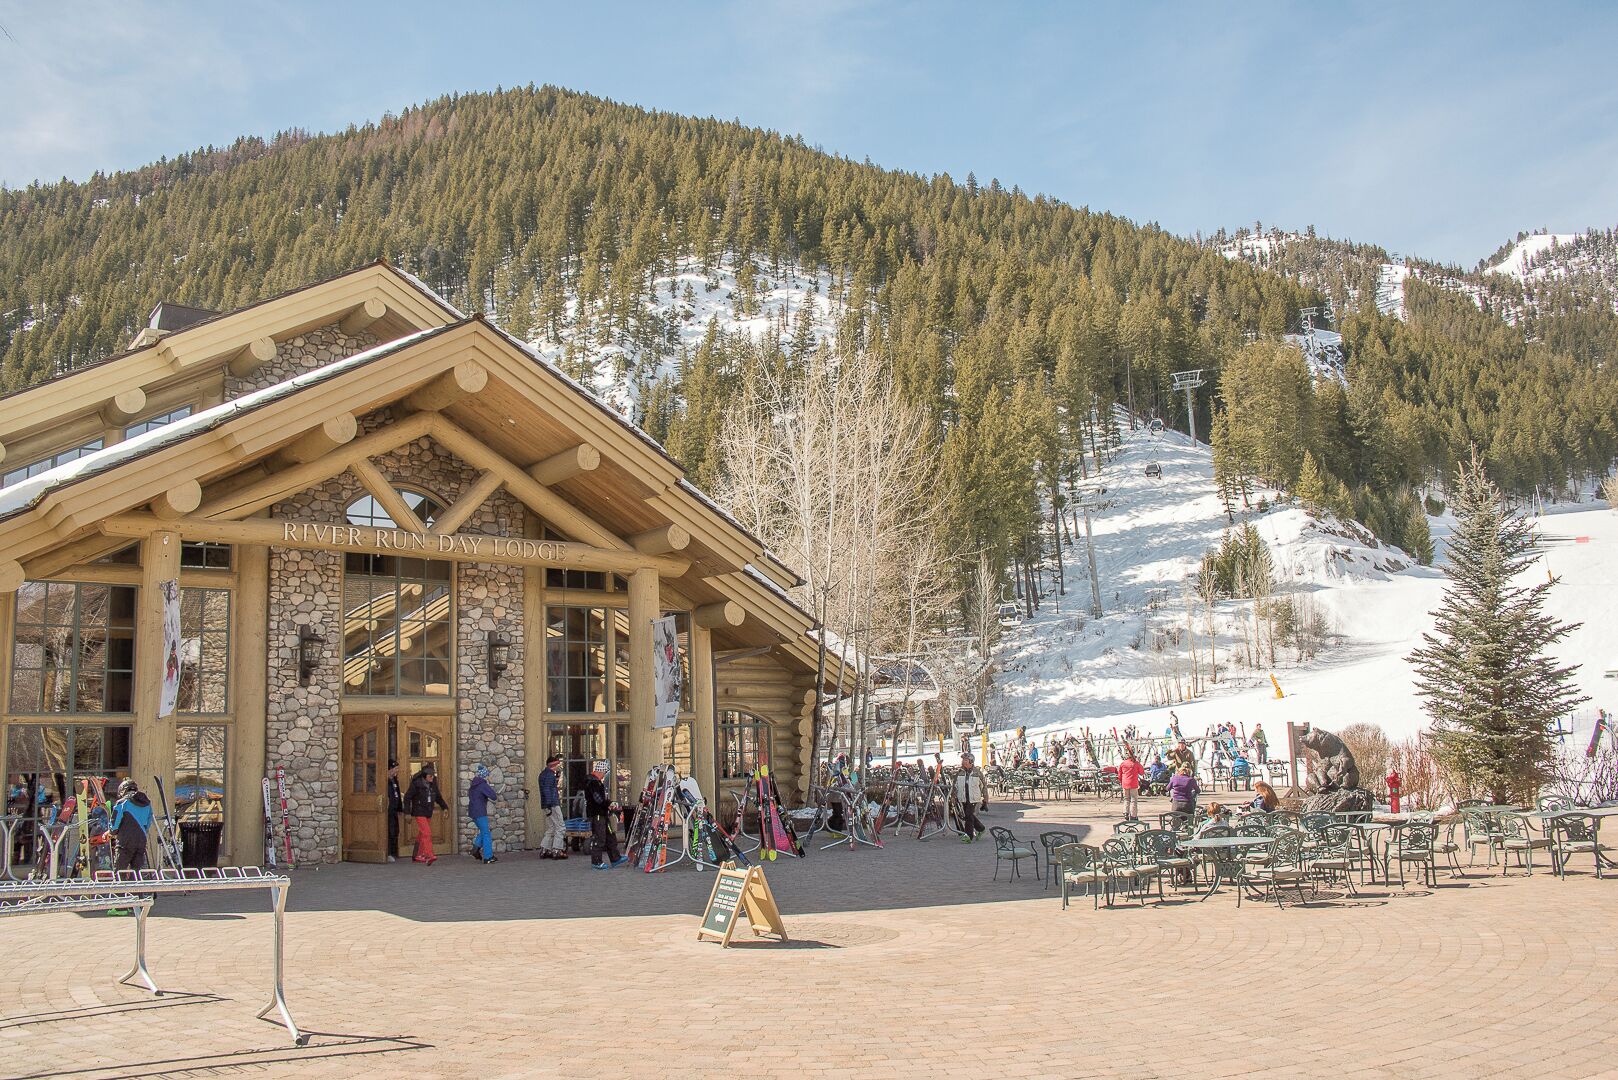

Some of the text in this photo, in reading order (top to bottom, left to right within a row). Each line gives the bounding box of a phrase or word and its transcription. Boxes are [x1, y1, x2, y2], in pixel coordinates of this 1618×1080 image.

[283, 522, 567, 561] RIVER RUN DAY LODGE
